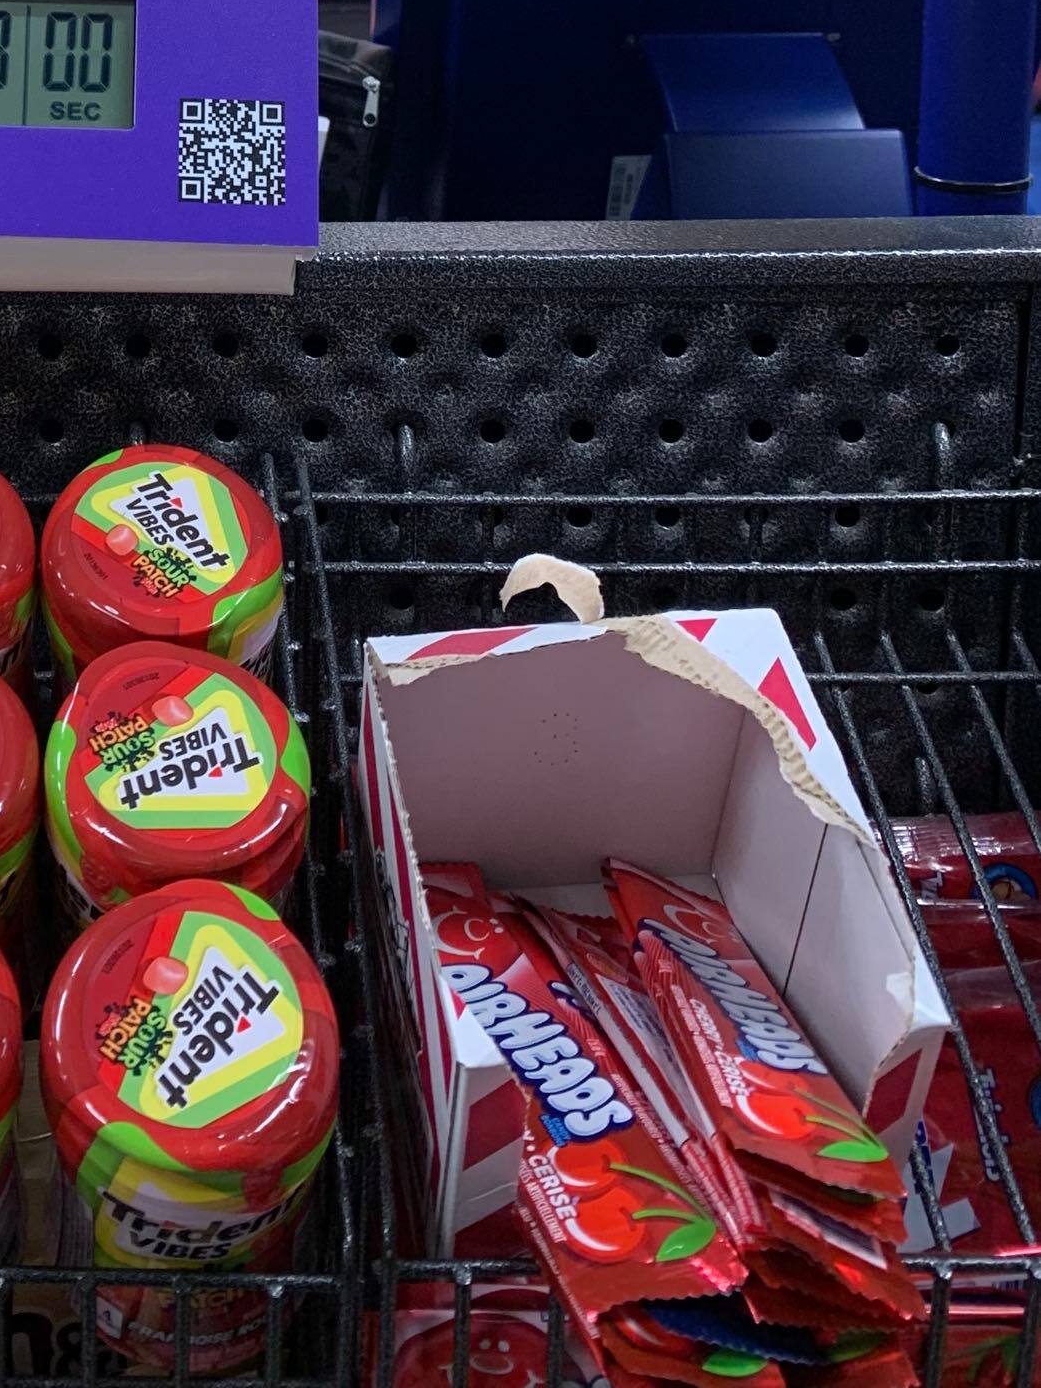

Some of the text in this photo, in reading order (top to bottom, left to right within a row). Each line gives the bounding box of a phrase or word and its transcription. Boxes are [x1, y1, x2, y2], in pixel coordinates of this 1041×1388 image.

[43, 12, 114, 92] 00
[49, 101, 101, 121] SEC
[126, 498, 174, 546] VIBES
[137, 473, 230, 567] Trident
[134, 556, 178, 598] PATCH
[149, 550, 190, 587] SOUR
[89, 715, 149, 752] PATCH
[100, 731, 155, 765] SOUR
[161, 722, 227, 761] VIBES
[120, 737, 260, 809] Trident
[172, 966, 233, 1036] VIBES
[643, 921, 828, 1073] AIRHEADS
[99, 998, 151, 1060] PATCH
[118, 1015, 166, 1068] SOUR
[158, 972, 279, 1109] Trident
[443, 964, 635, 1137] AIRHEADS
[715, 1052, 749, 1099] CERISE
[529, 1156, 578, 1222] CERISE
[129, 1231, 232, 1259] VIBES
